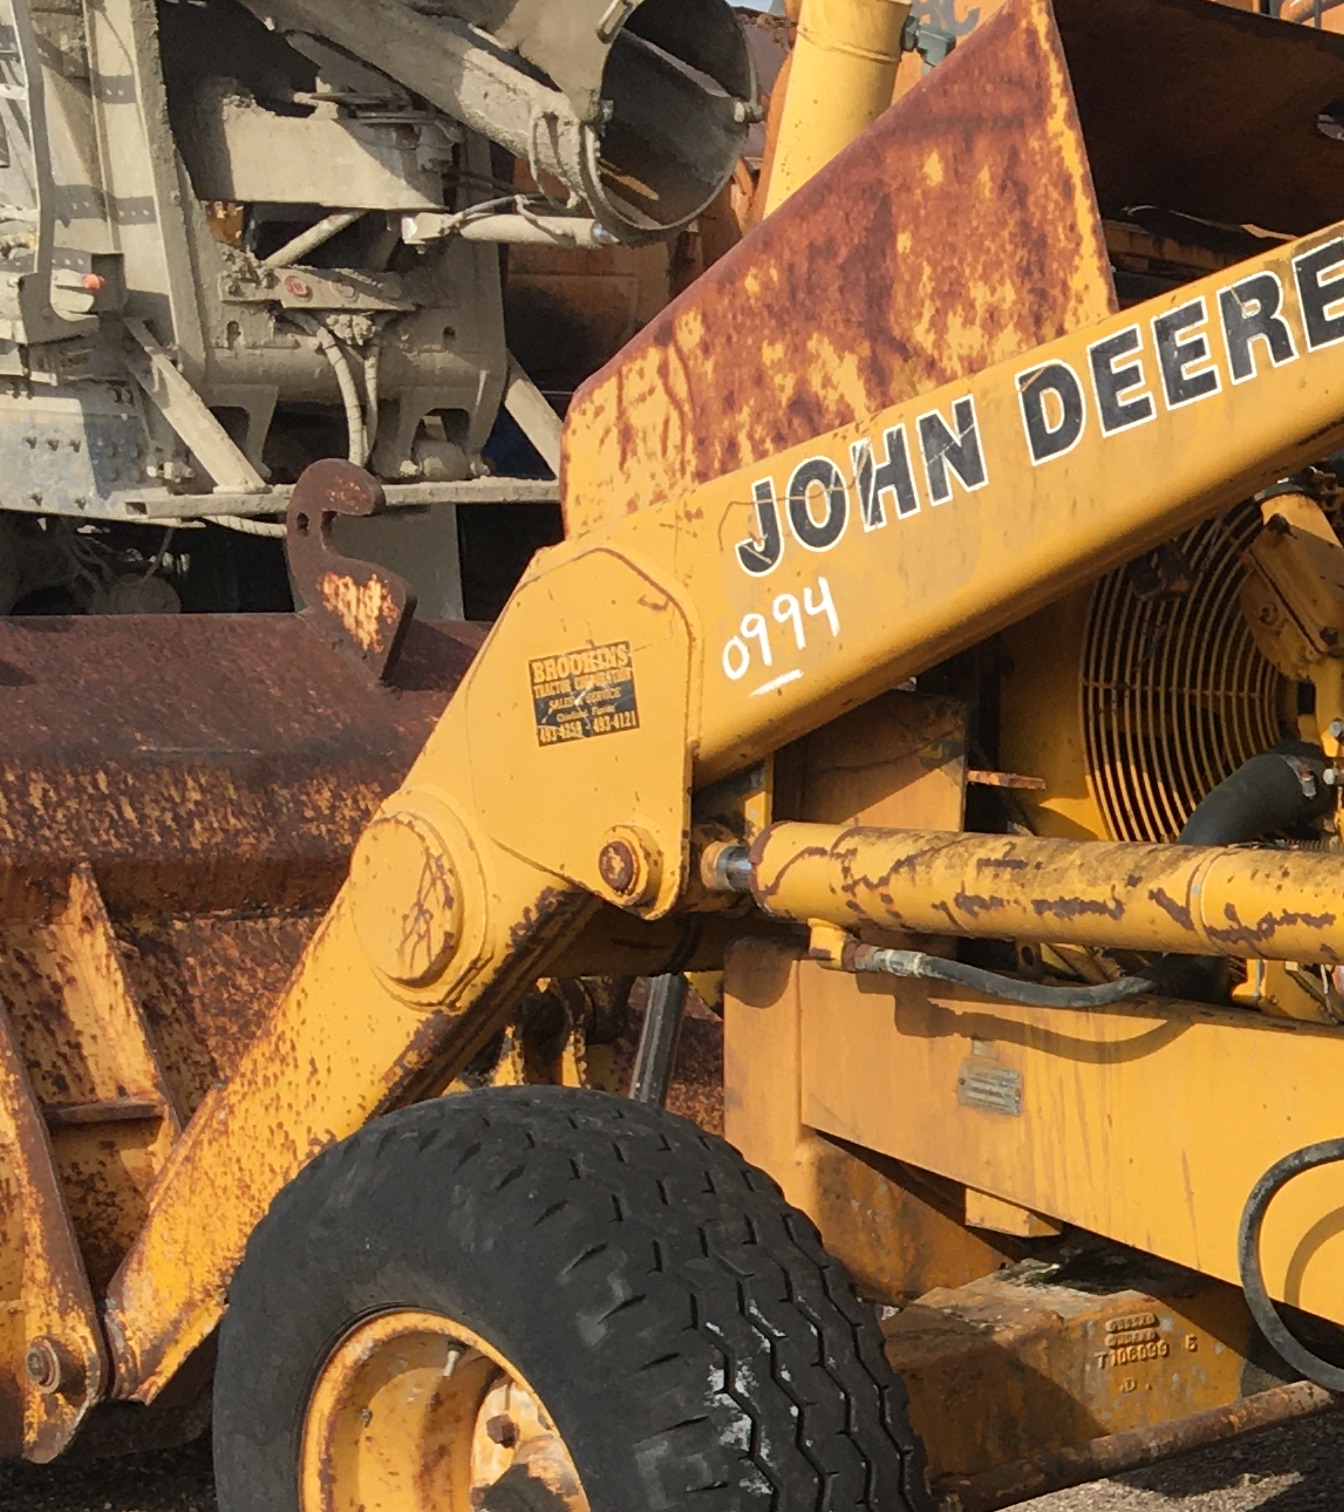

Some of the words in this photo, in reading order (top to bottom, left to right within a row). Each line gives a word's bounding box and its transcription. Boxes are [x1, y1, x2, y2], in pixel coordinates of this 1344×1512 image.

[735, 394, 988, 577] JOHN
[531, 643, 630, 684] BROOKINS
[722, 577, 840, 681] 0994
[593, 711, 637, 733] 493-4121
